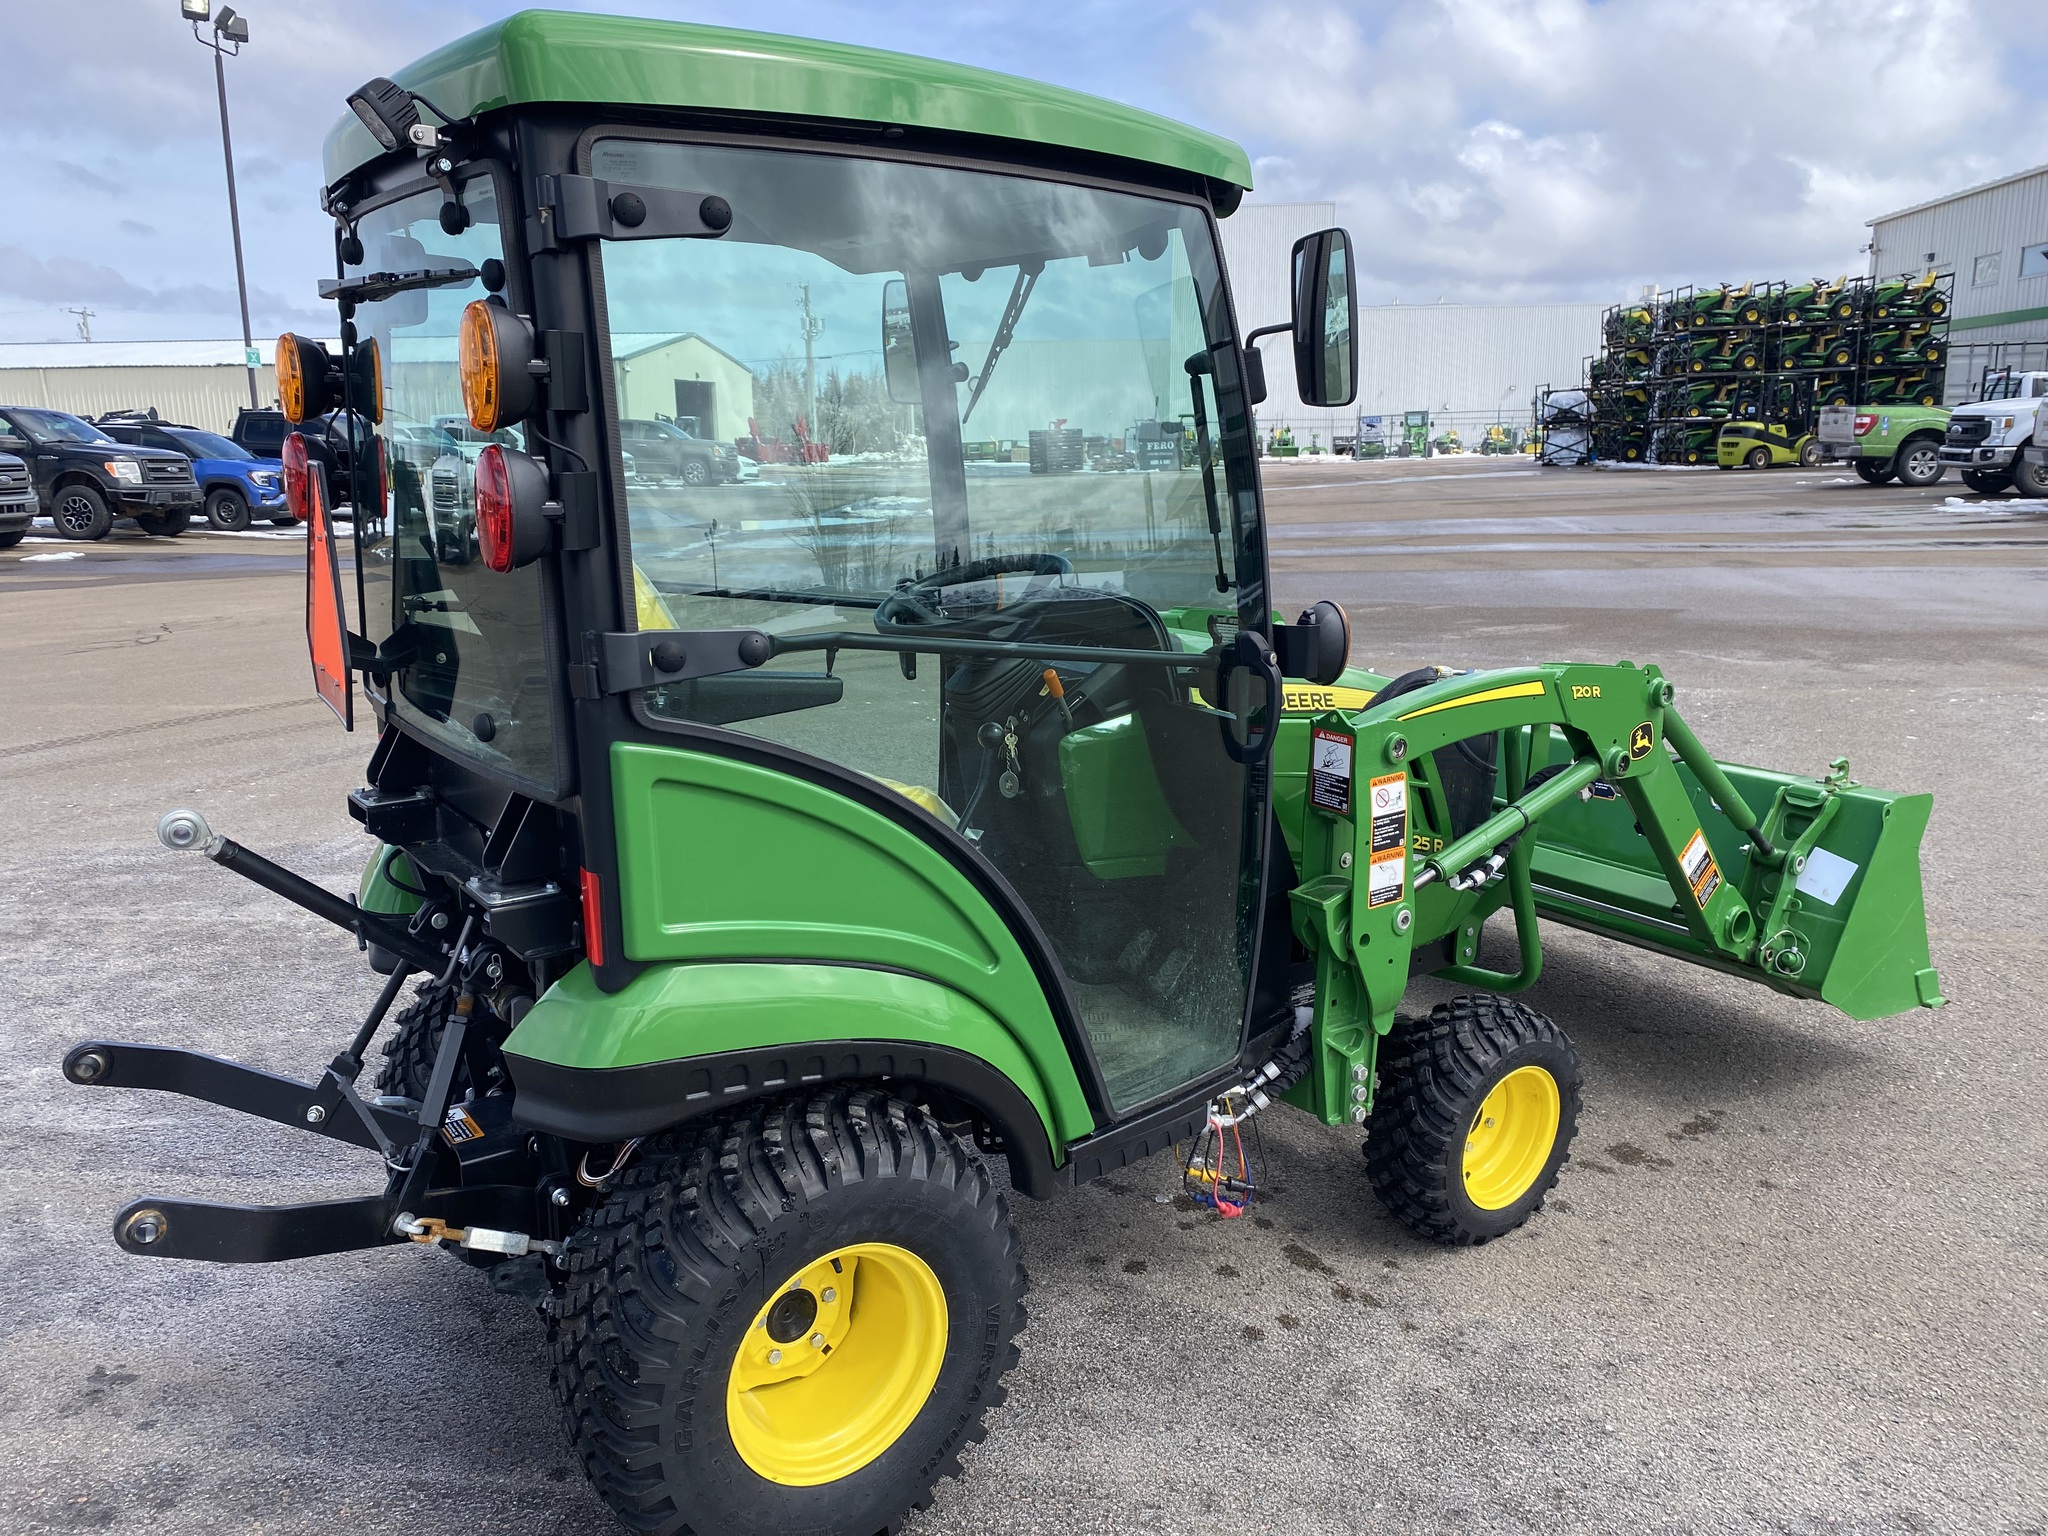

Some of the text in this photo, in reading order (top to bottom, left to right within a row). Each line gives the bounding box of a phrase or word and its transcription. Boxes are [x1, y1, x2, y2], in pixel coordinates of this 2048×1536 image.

[1147, 441, 1174, 450] FERO
[1325, 733, 1348, 744] DANGER
[1377, 773, 1404, 785] WARNING
[1376, 851, 1404, 862] WARNING
